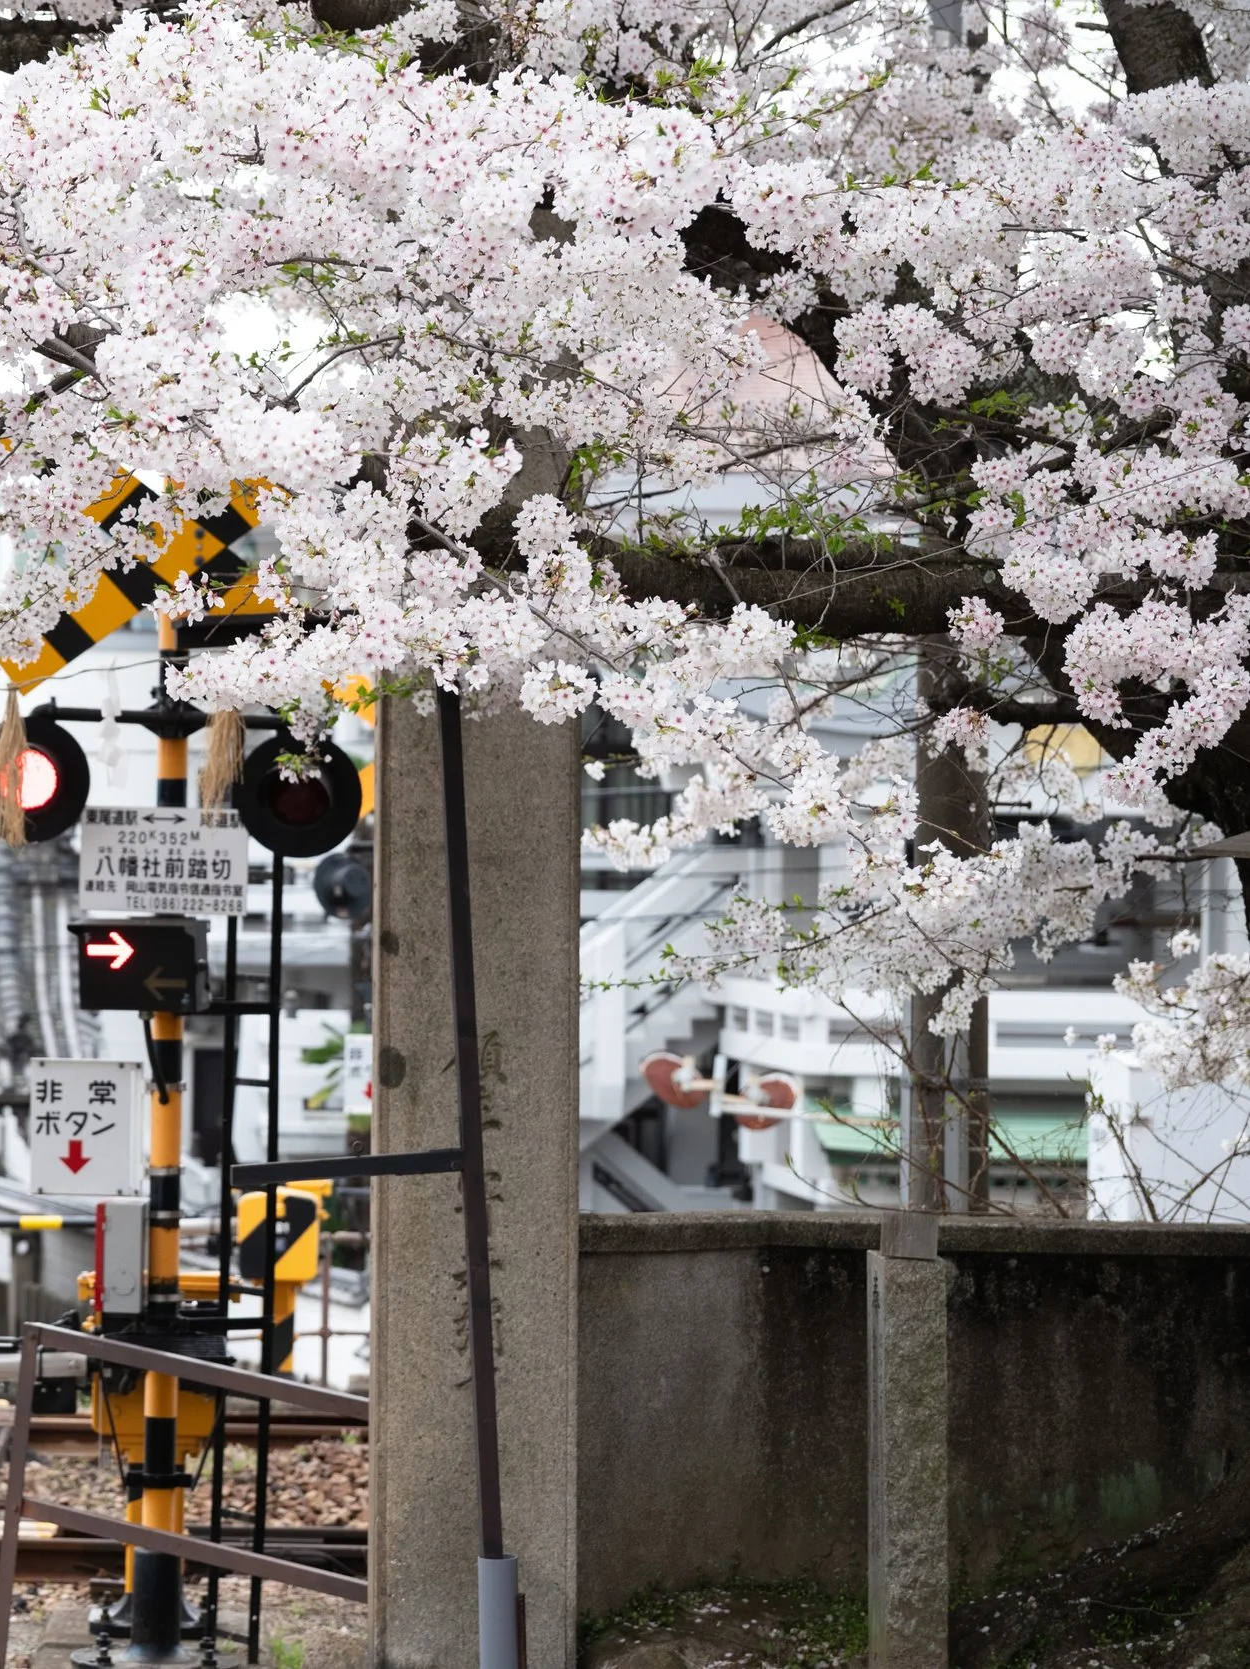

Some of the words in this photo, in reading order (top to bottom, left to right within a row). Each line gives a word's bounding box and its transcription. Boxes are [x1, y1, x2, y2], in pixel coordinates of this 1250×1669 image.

[95, 855, 232, 880] 八幡社前踏切
[85, 880, 116, 893] 連絡先
[36, 1111, 116, 1136] ボタン
